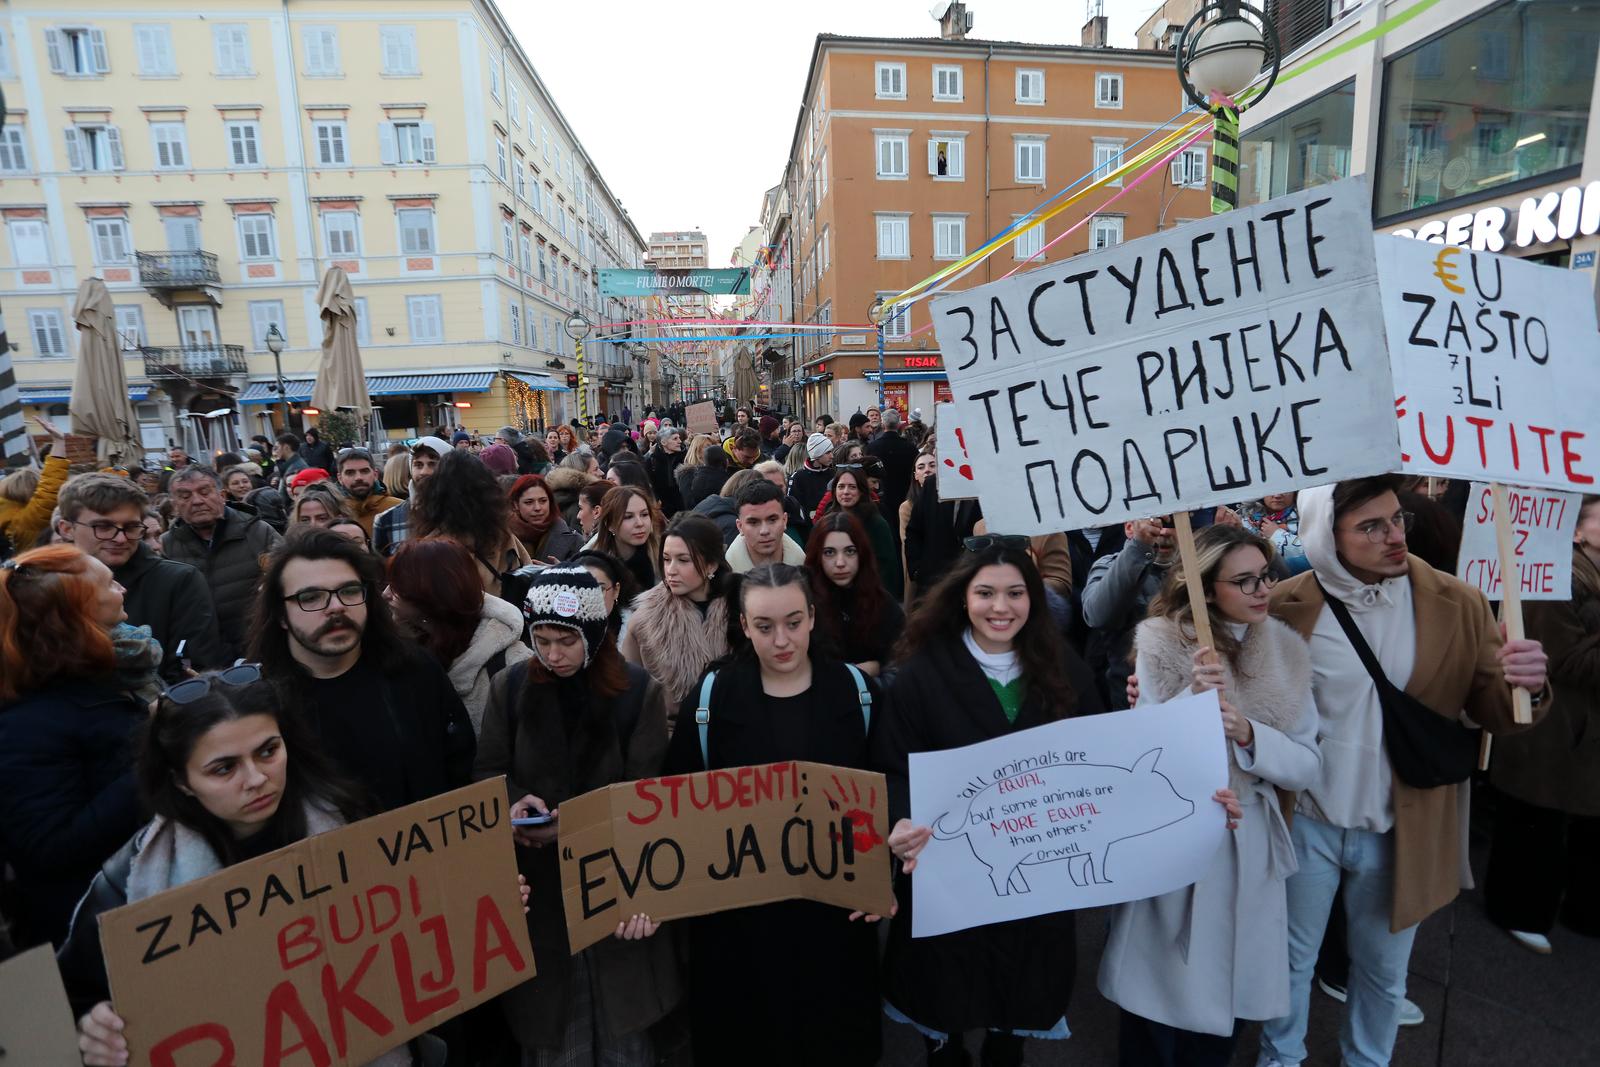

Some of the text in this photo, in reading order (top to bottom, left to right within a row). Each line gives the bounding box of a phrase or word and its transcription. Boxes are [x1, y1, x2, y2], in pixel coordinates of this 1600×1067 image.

[636, 276, 668, 288] FIUME
[676, 275, 714, 287] MORTE!
[1402, 292, 1549, 365] ZAŠTO
[904, 357, 938, 367] TISAK
[968, 307, 1353, 453] ТЕЧЕ РИЈЕКА
[1025, 398, 1328, 523] ПОДРШКЕ
[1394, 395, 1595, 484] UTITE
[993, 751, 1060, 780] animals
[1065, 751, 1087, 762] are
[998, 772, 1046, 795] EQUAL,
[626, 761, 809, 825] STUDENTI:
[969, 785, 1113, 825] but some animals are
[990, 802, 1101, 837] MORE EQUAL
[1009, 833, 1042, 847] than
[707, 823, 766, 880] JA
[1036, 842, 1081, 861] Orwell
[136, 797, 500, 964] ZAPALI VATRU
[276, 874, 422, 971] BUDI
